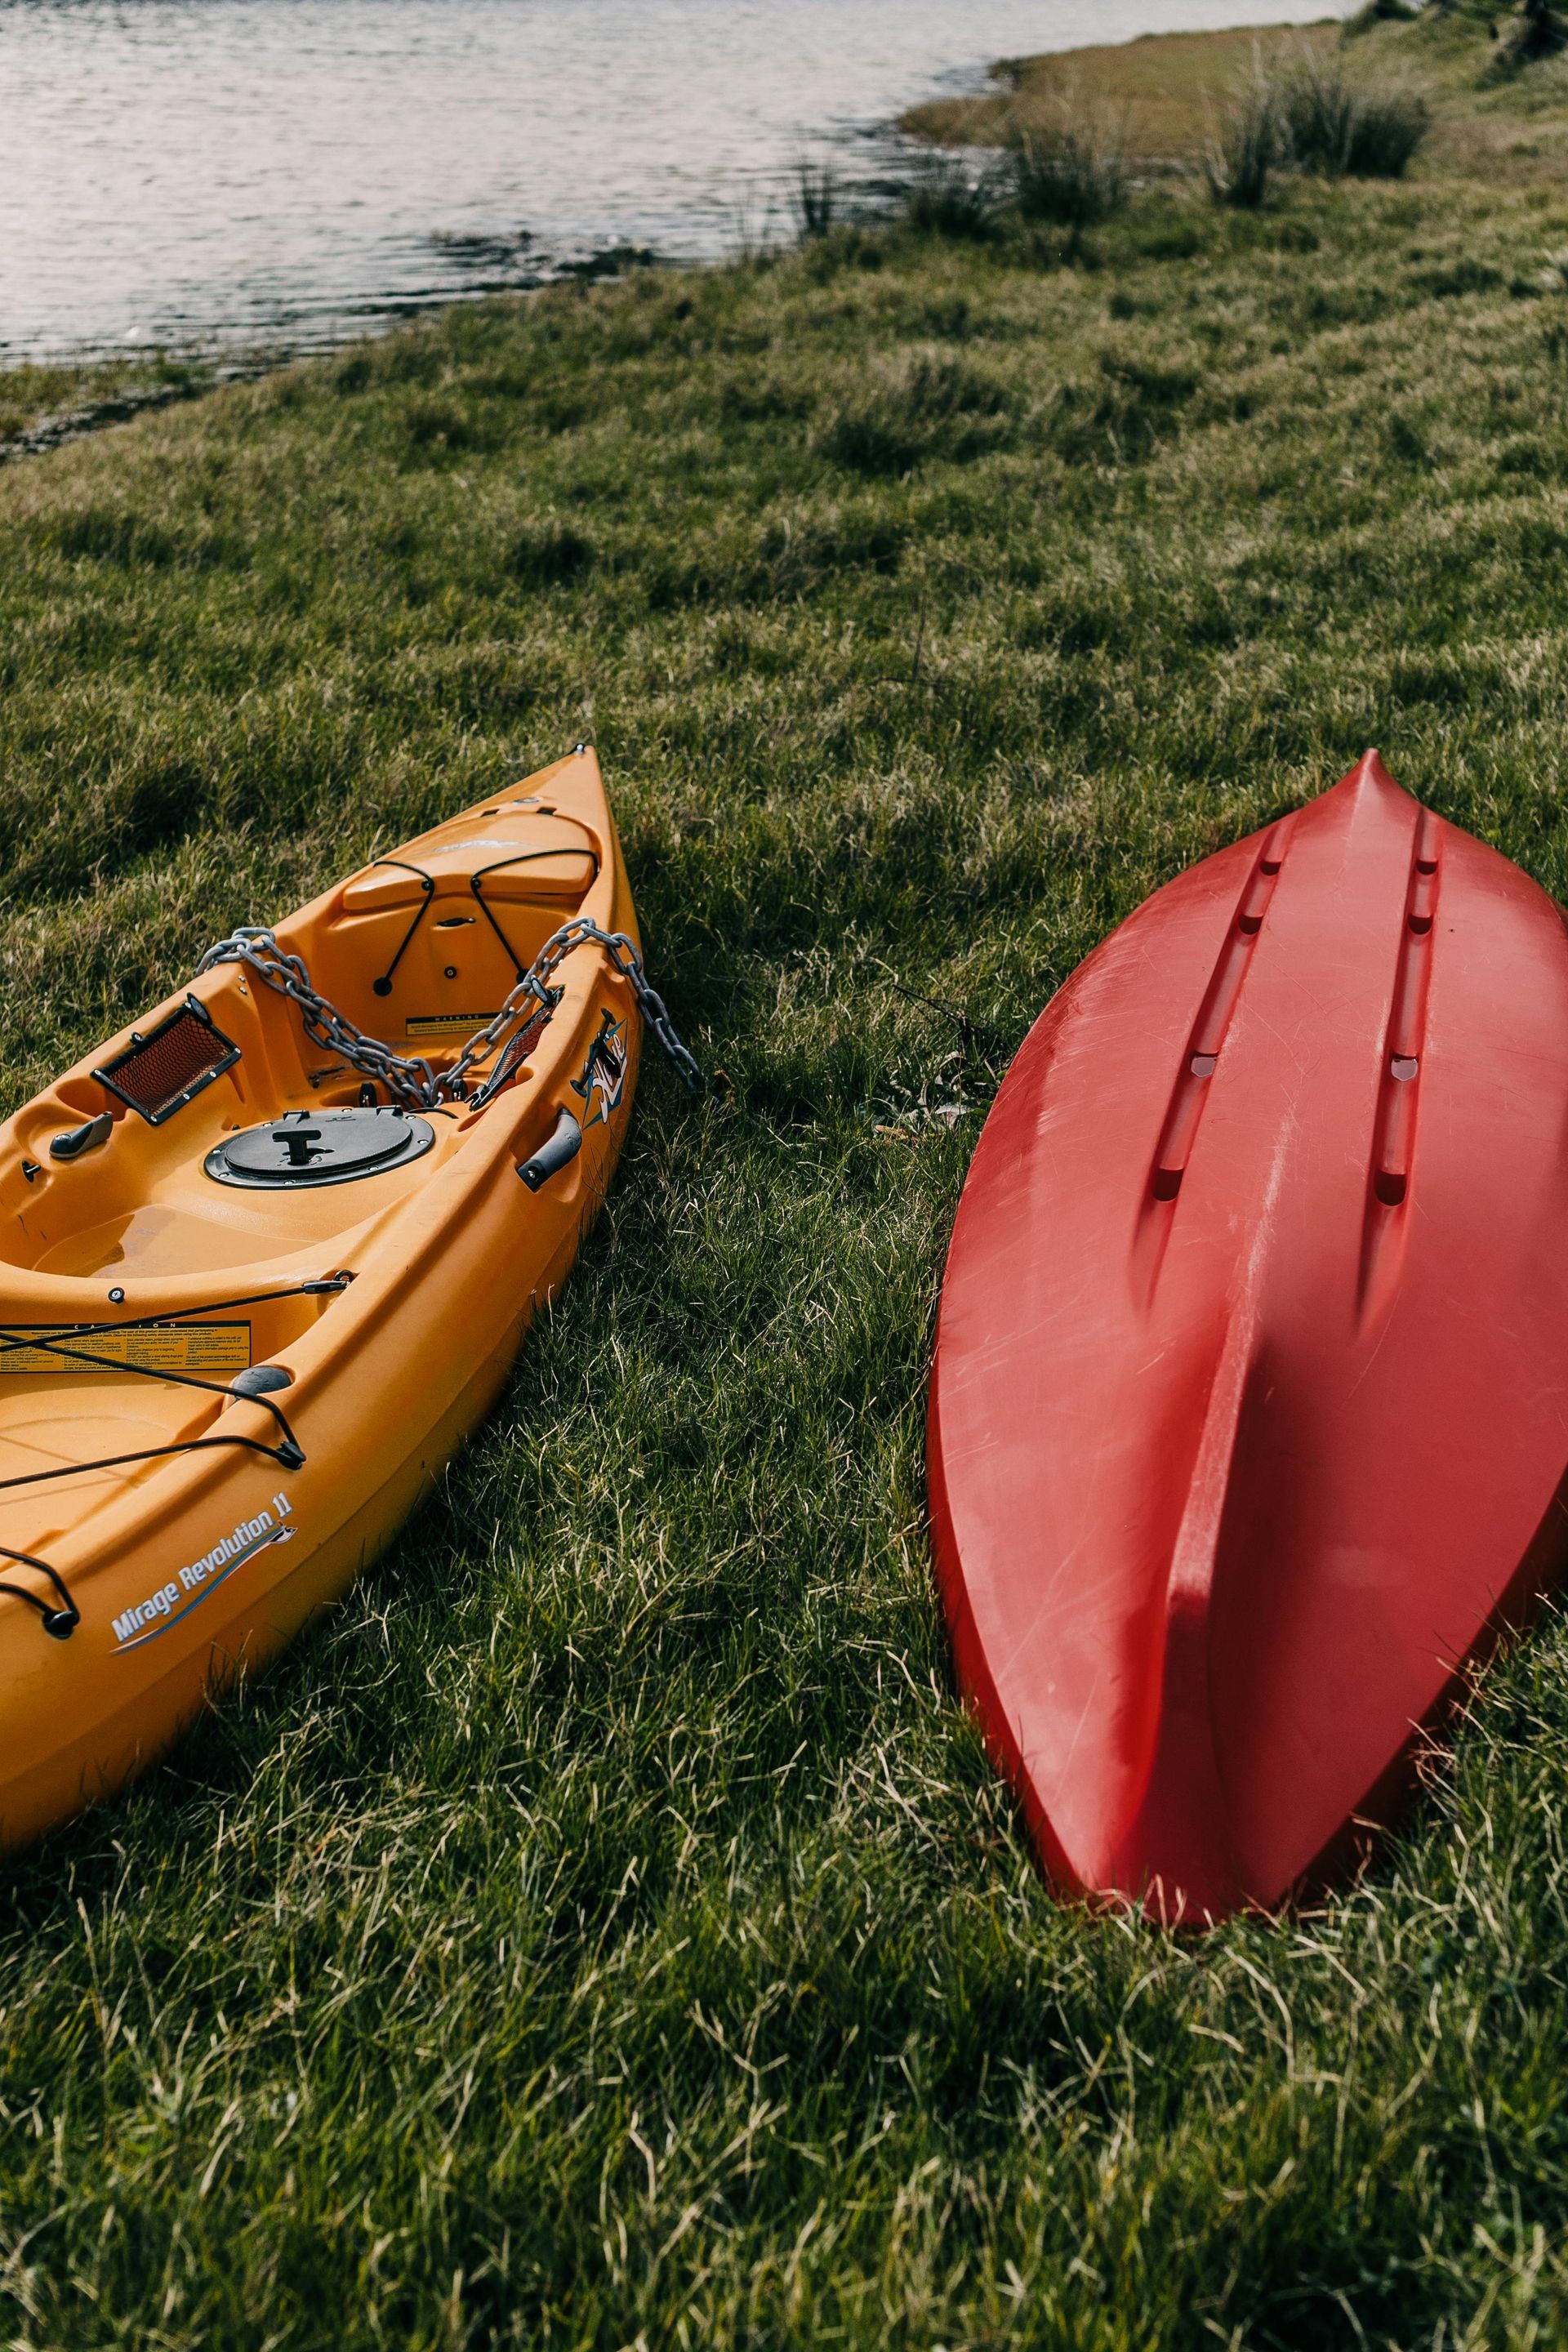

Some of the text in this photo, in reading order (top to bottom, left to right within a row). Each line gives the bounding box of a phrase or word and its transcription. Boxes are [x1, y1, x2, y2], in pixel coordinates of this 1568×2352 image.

[110, 1491, 293, 1642] Mirage Revolution 11
